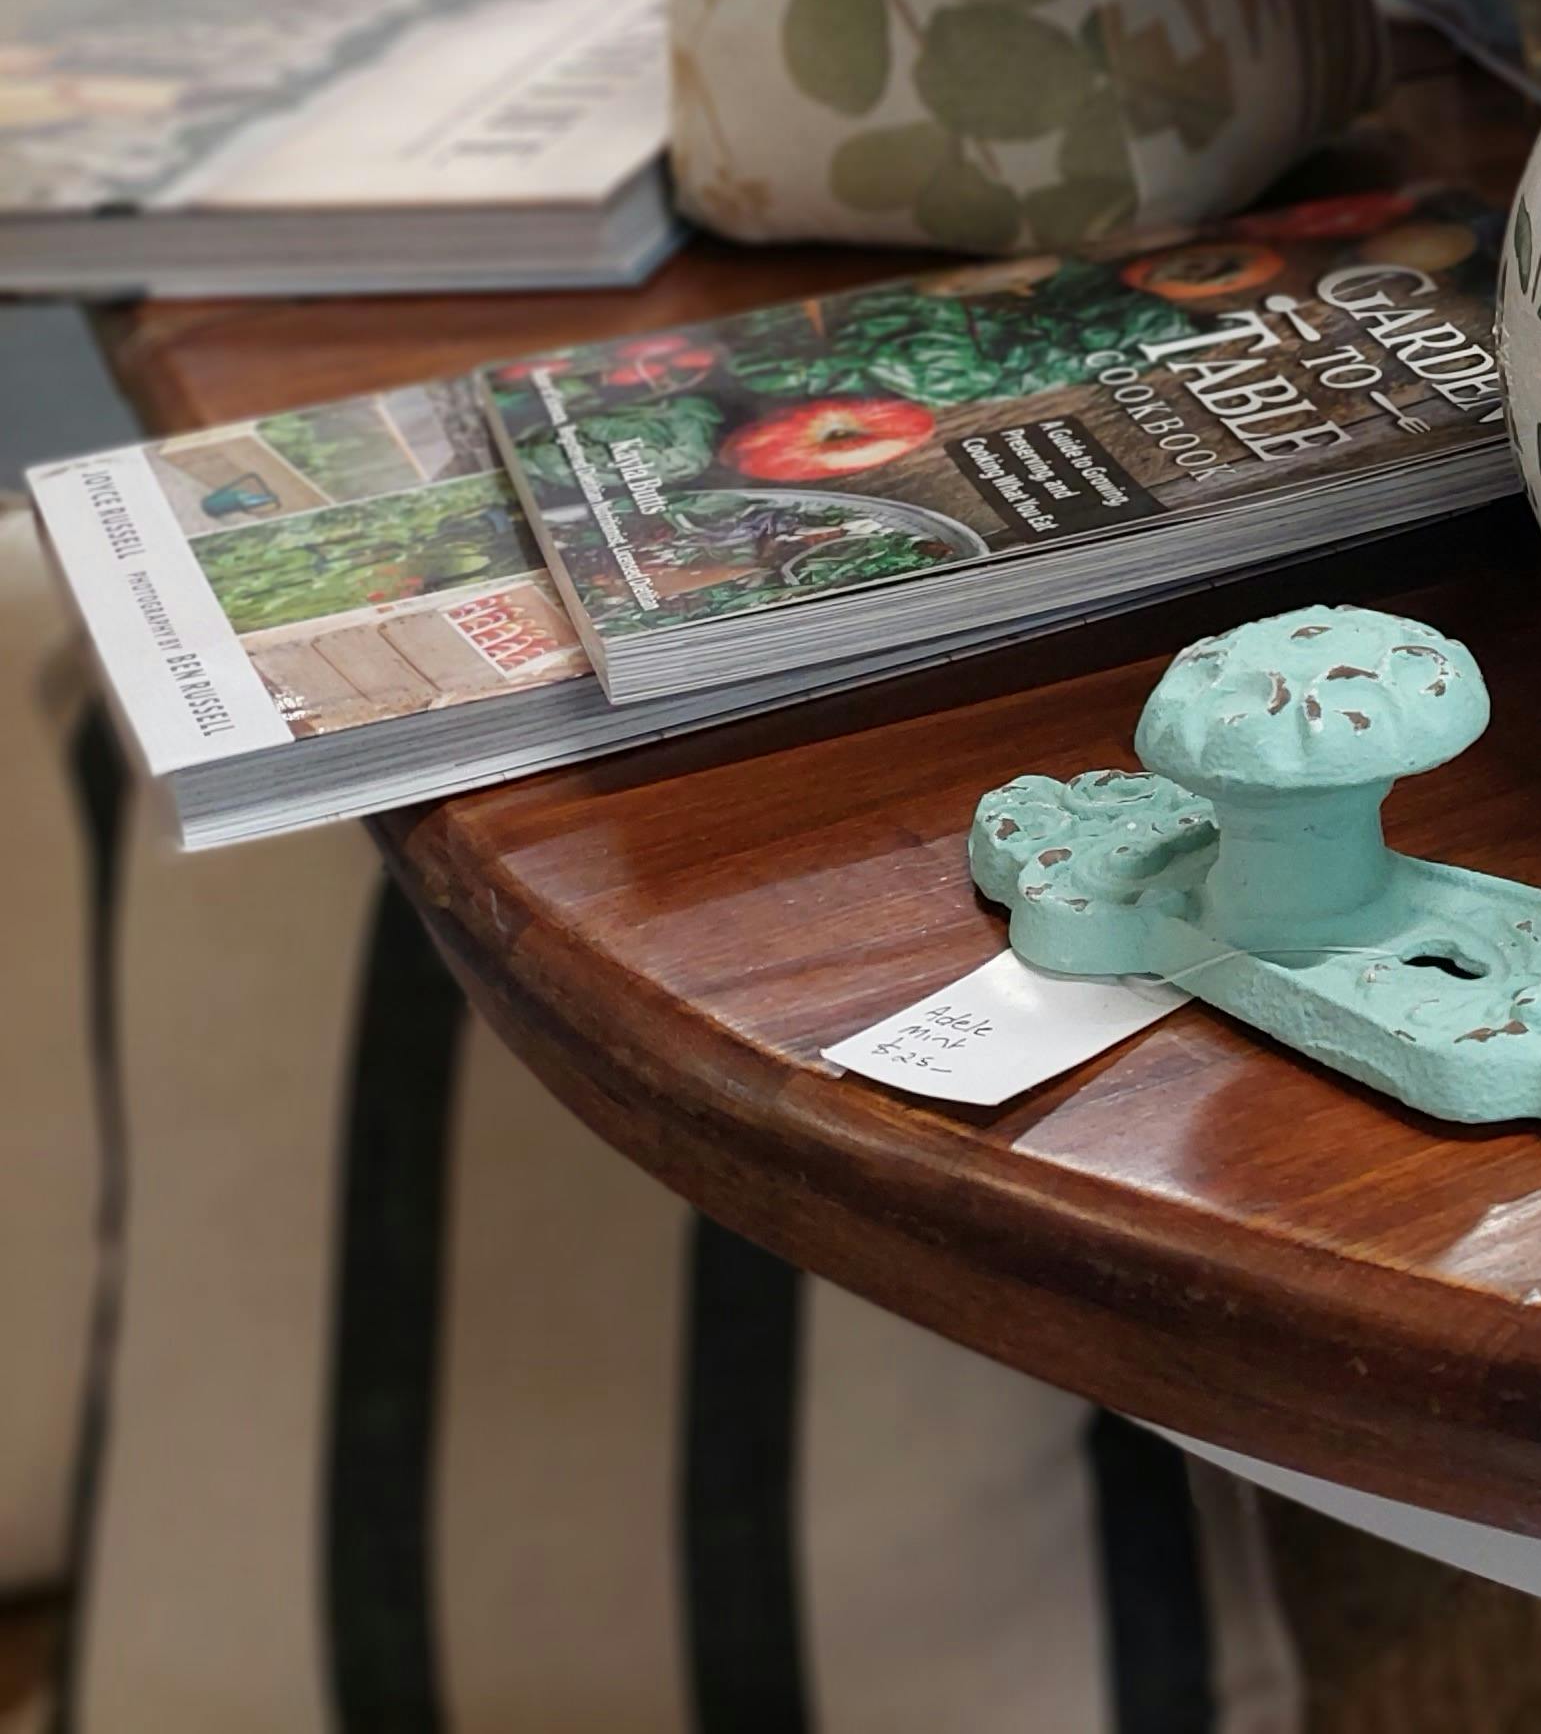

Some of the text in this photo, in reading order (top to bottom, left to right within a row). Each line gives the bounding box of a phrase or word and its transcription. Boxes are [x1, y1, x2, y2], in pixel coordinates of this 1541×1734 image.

[1137, 309, 1353, 463] TABLE
[1300, 345, 1383, 390] TO
[1037, 420, 1065, 431] A
[1085, 349, 1238, 482] COOKBOOK
[1047, 428, 1086, 458] Guide
[1070, 454, 1093, 469] to
[607, 437, 669, 515] Kayla Butts
[961, 437, 1060, 533] Cooking What You Eat
[1043, 479, 1082, 500] and
[82, 469, 236, 738] JOYCE RUSSELL PHOTOGRAPHY BY BEN RUSSELL
[898, 1026, 967, 1049] Mint
[926, 1006, 993, 1037] Adele
